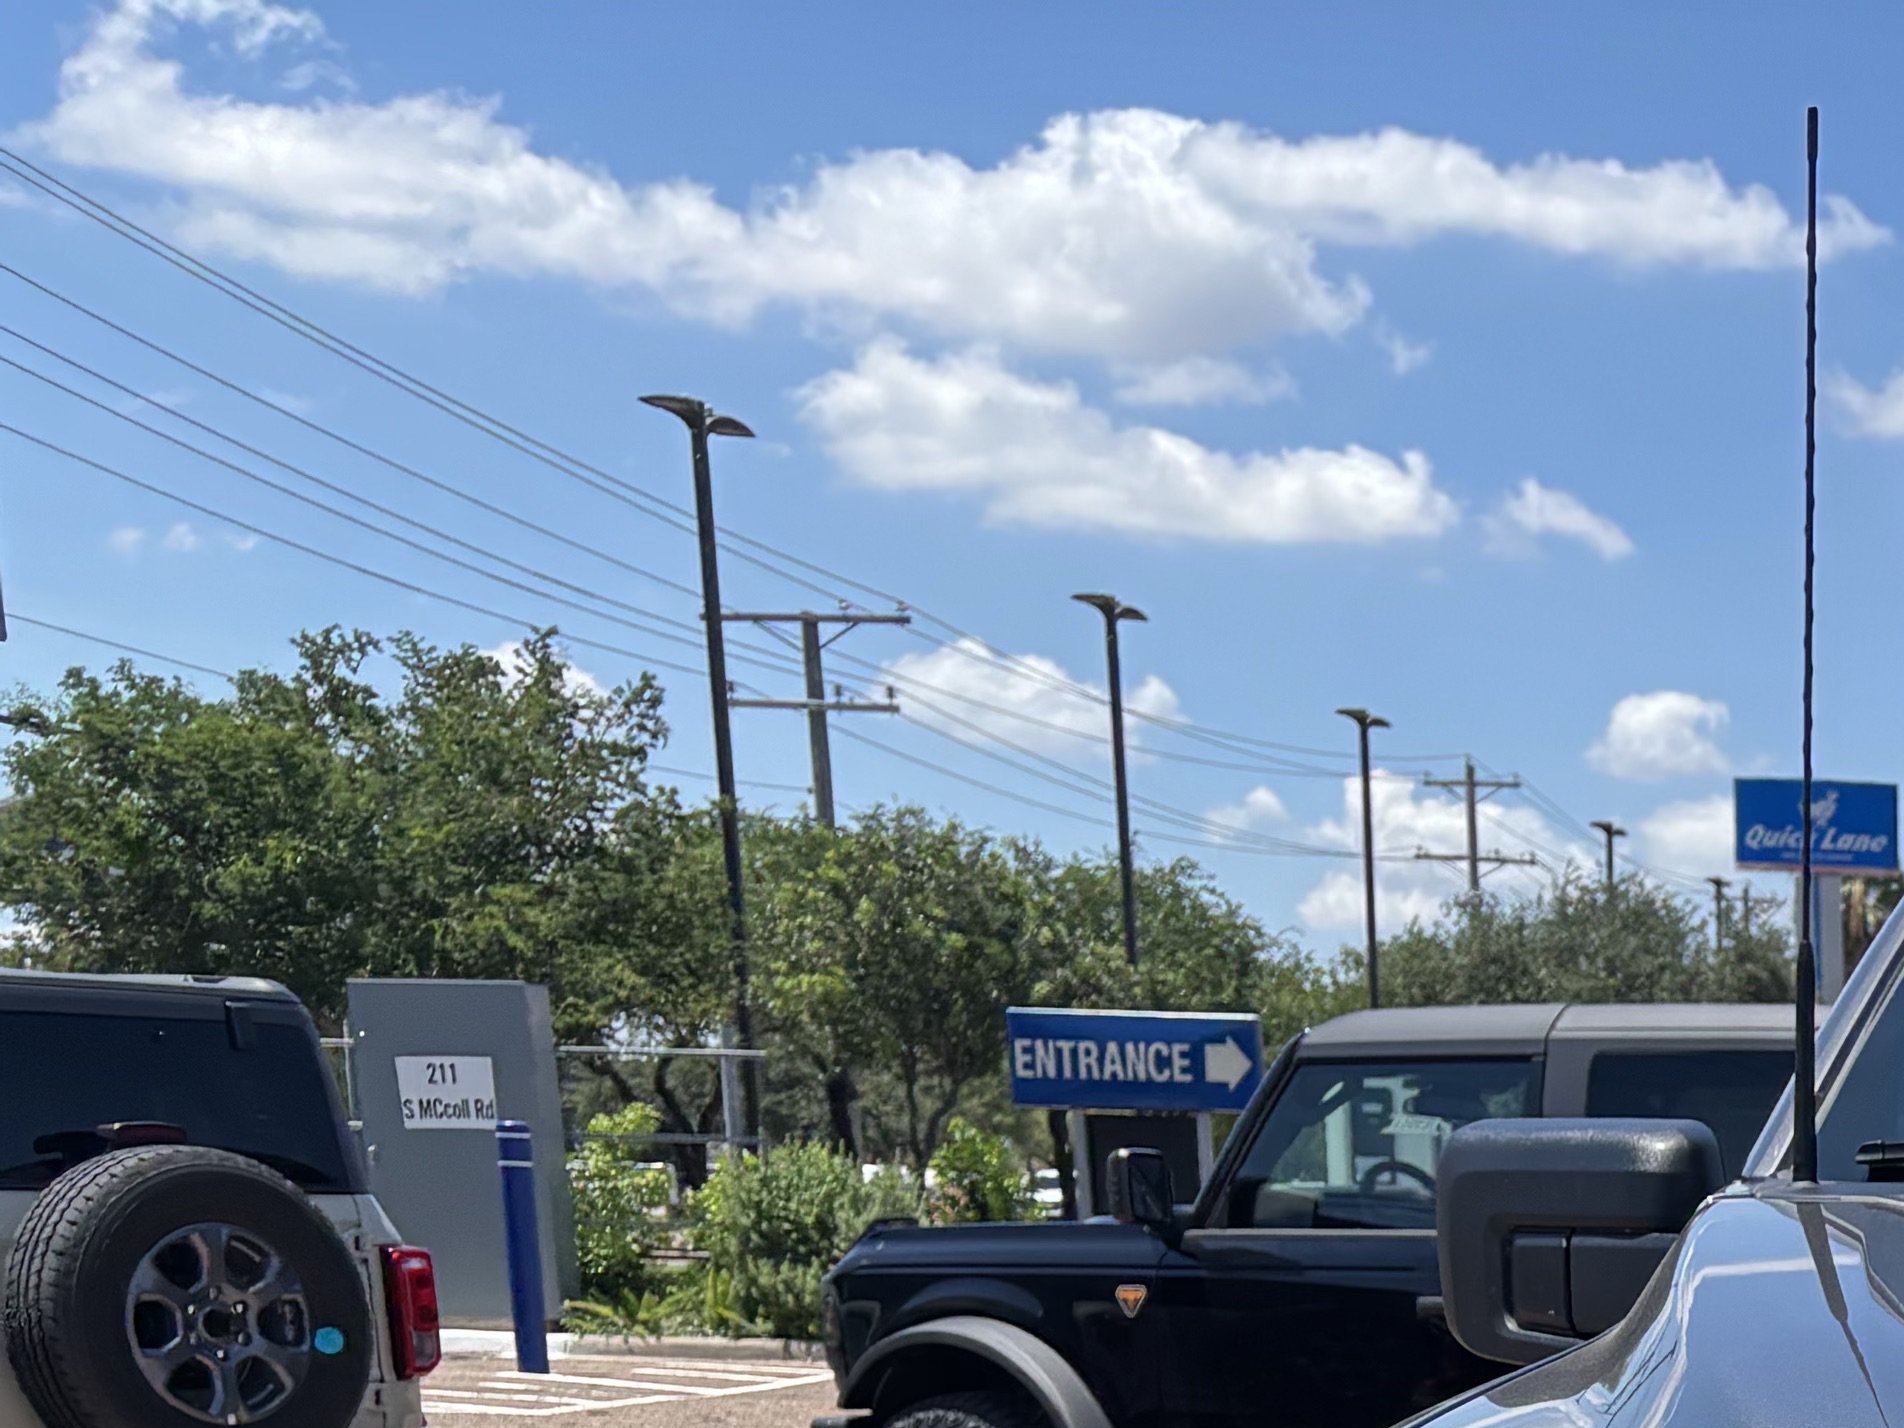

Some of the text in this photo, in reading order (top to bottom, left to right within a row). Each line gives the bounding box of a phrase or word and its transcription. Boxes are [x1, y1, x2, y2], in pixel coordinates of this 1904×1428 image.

[1820, 827, 1888, 852] Lane
[1014, 1038, 1193, 1083] ENTRANCE
[426, 1062, 457, 1085] 211
[403, 1098, 415, 1119] S
[474, 1098, 494, 1119] Rd
